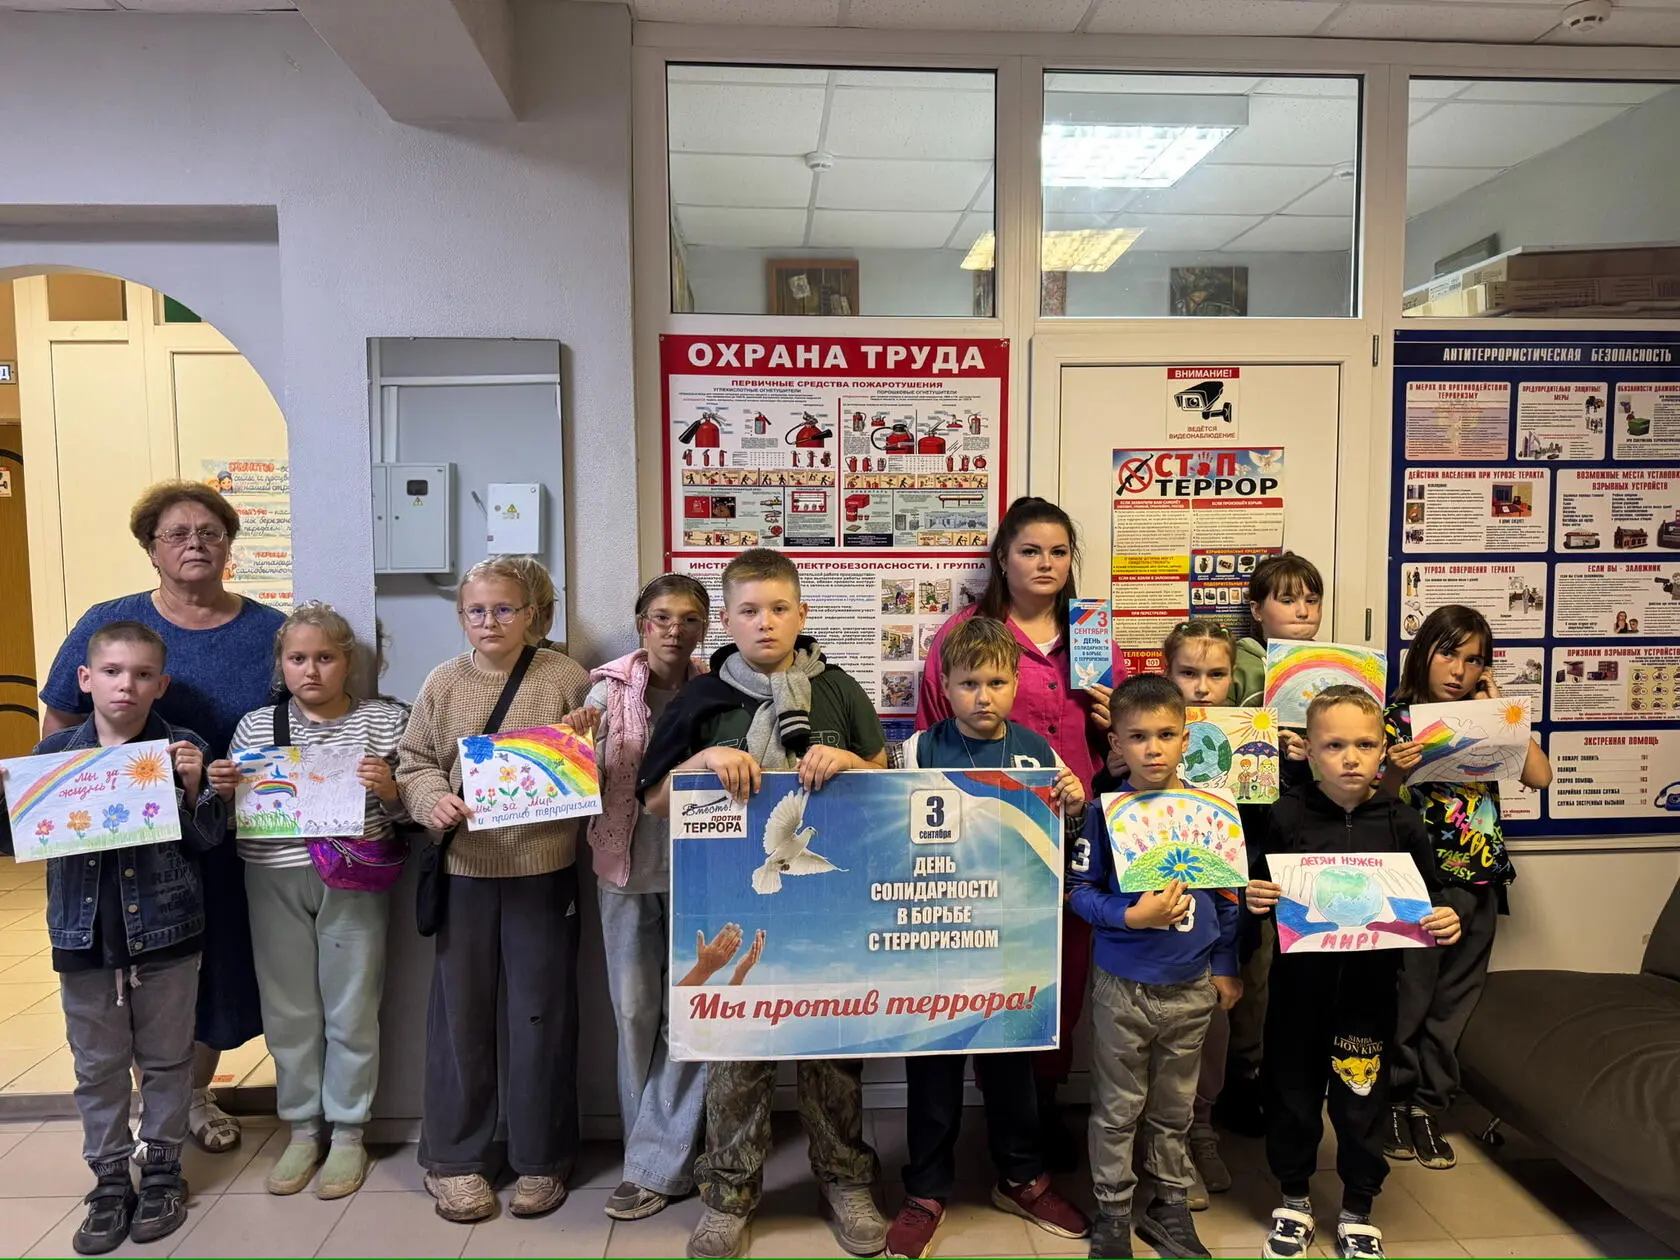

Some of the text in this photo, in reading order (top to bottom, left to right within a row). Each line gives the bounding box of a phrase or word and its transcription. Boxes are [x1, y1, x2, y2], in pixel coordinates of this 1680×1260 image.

[688, 343, 985, 374] ОХРАНА ТРУДА
[1443, 348, 1672, 362] АНТИТЕРРОРИСТИЧЕСКАЯ БЕЗОПАСНОСТЬ
[1175, 369, 1232, 378] ВНИМАНИЕ!
[1168, 432, 1235, 440] ВИДЕОНАБЛЮДЕНИЕ
[1408, 470, 1439, 480] ДЕЙСТВИЯ
[1494, 471, 1516, 479] УГРОЗЕ
[1519, 471, 1544, 479] ТЕРАКТА
[1576, 471, 1680, 479] ВОЗМОЖНЫЕ МЕСТА УСТАНОВК
[1155, 478, 1278, 496] ТЕРРОР
[1592, 481, 1668, 490] ВЗРЫВНЫХ УСТРОЙСТВ
[690, 562, 727, 570] ИНСТР
[797, 562, 933, 570] ЛЕКТРОБЕЗОПАСНОСТИ.
[943, 562, 986, 570] ГРУППА
[1097, 611, 1108, 628] 3
[1074, 627, 1109, 635] СЕНТЯБРЯ
[1567, 649, 1601, 657] ПРИЗНАКИ
[1604, 648, 1641, 657] ВЗРЫВНЫХ
[1584, 736, 1659, 746] ЭКСТРЕННАЯ ПОМОЩЬ
[491, 807, 530, 823] против
[535, 800, 598, 816] терроризма
[502, 802, 518, 811] за
[926, 796, 945, 827] 3
[711, 815, 742, 823] против
[684, 822, 742, 833] ТЕРРОРА
[919, 829, 952, 839] сентября
[1071, 838, 1091, 872] 3
[1341, 856, 1383, 868] НУЖЕН
[1436, 848, 1470, 864] TAKE
[913, 856, 956, 877] ДЕНЬ
[1440, 861, 1476, 880] EASY
[871, 880, 998, 902] СОЛИДАРНОСТИ
[897, 905, 972, 925] В БОРЬБЕ
[868, 930, 999, 951] С ТЕРРОРИЗМОМ
[689, 985, 1037, 1025] Мы против террора!
[1333, 1035, 1384, 1055] LION KING
